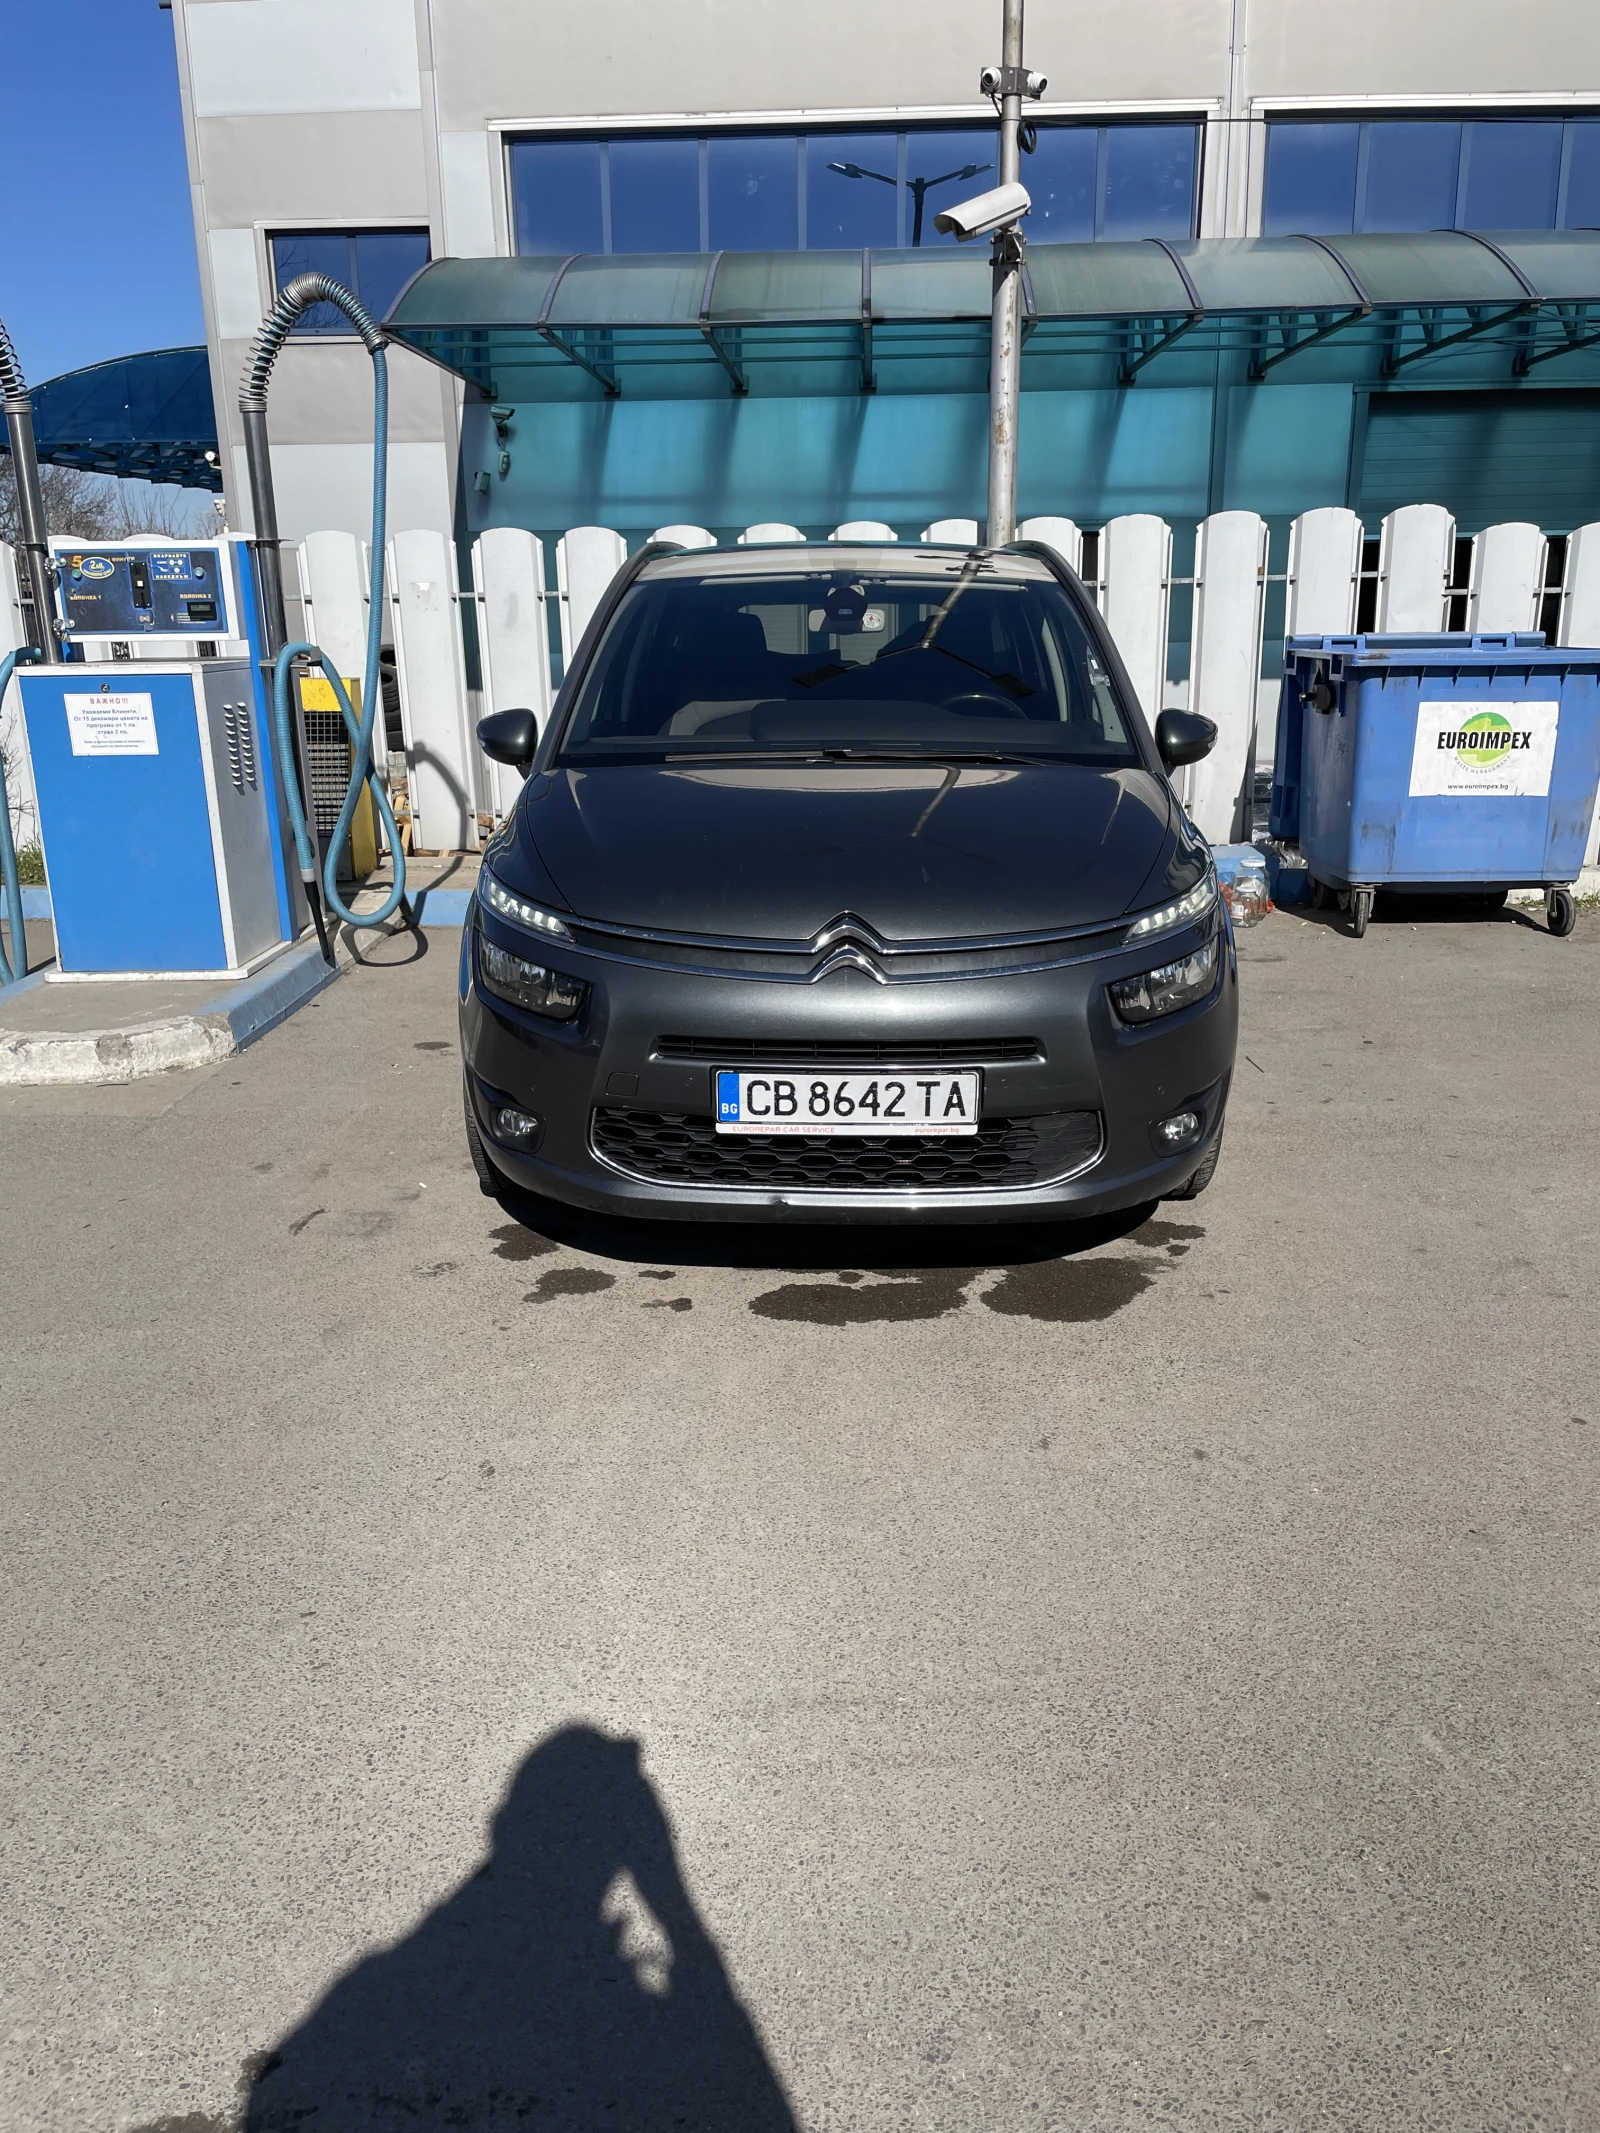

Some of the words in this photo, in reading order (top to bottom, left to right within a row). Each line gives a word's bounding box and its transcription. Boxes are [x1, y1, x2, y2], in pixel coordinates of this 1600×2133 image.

[71, 555, 82, 567] 5
[1437, 731, 1532, 750] EUROIMPEX
[1454, 755, 1469, 772] WASTE
[1470, 755, 1512, 775] MANAGEMENT
[747, 1079, 798, 1116] CB
[808, 1080, 906, 1117] 8642
[916, 1080, 967, 1117] TA
[721, 1103, 738, 1114] BG
